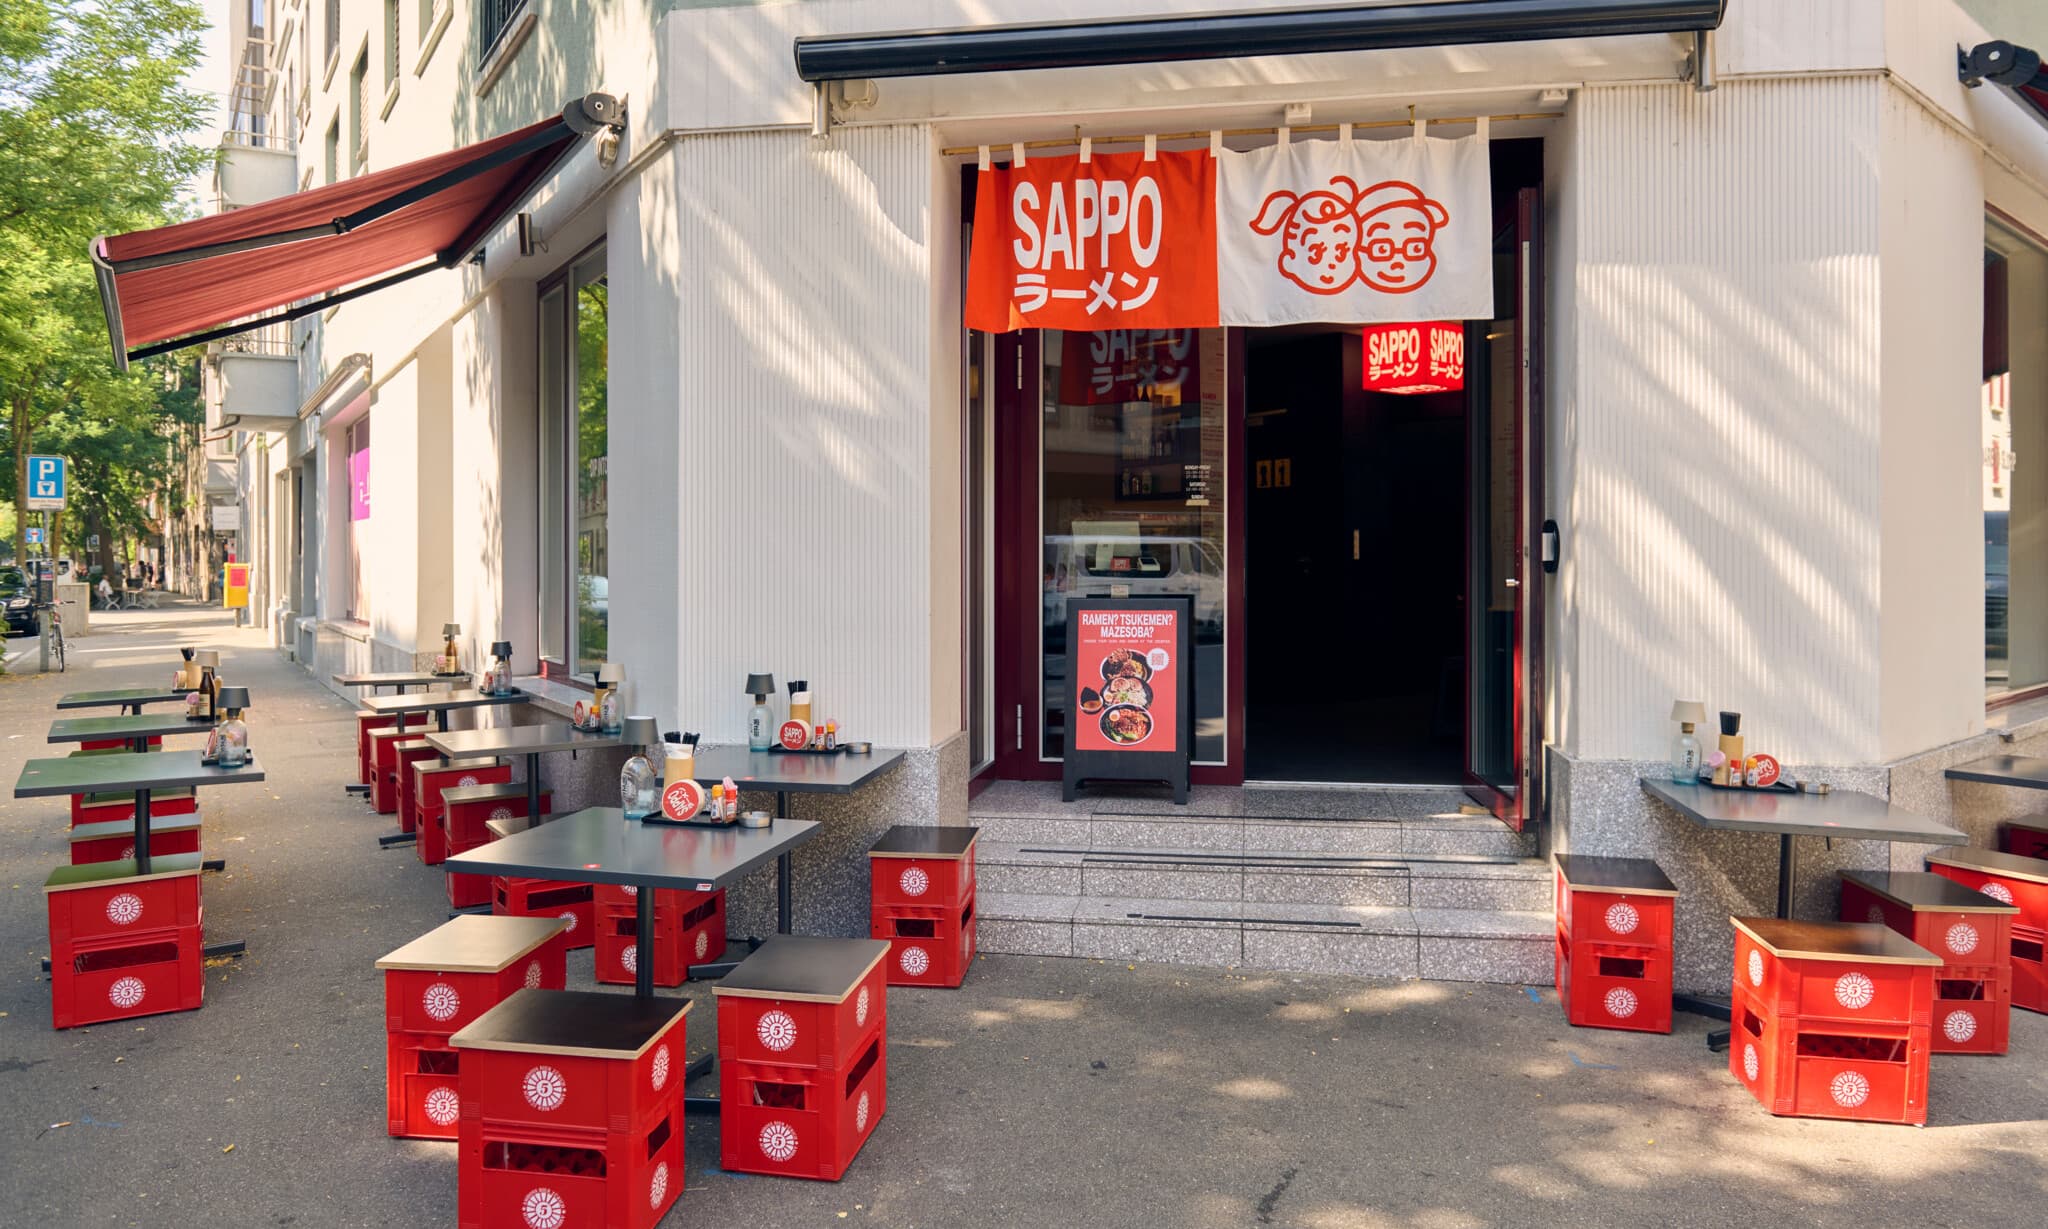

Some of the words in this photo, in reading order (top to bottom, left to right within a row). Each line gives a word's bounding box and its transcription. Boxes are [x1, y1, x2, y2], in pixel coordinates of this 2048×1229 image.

[1012, 176, 1163, 272] SAPPO
[1013, 270, 1159, 315] ラーメン
[1368, 327, 1421, 366] SAPPO
[1429, 327, 1464, 366] SAPPO
[1368, 361, 1420, 381] ラーメン
[1429, 361, 1464, 380] ラーメン
[39, 460, 55, 480] P
[1082, 613, 1119, 626] RAMEN?
[1119, 613, 1173, 626] TSUKEMEN?
[1100, 625, 1154, 638] MAZESOBA?
[784, 726, 803, 739] SAPPO
